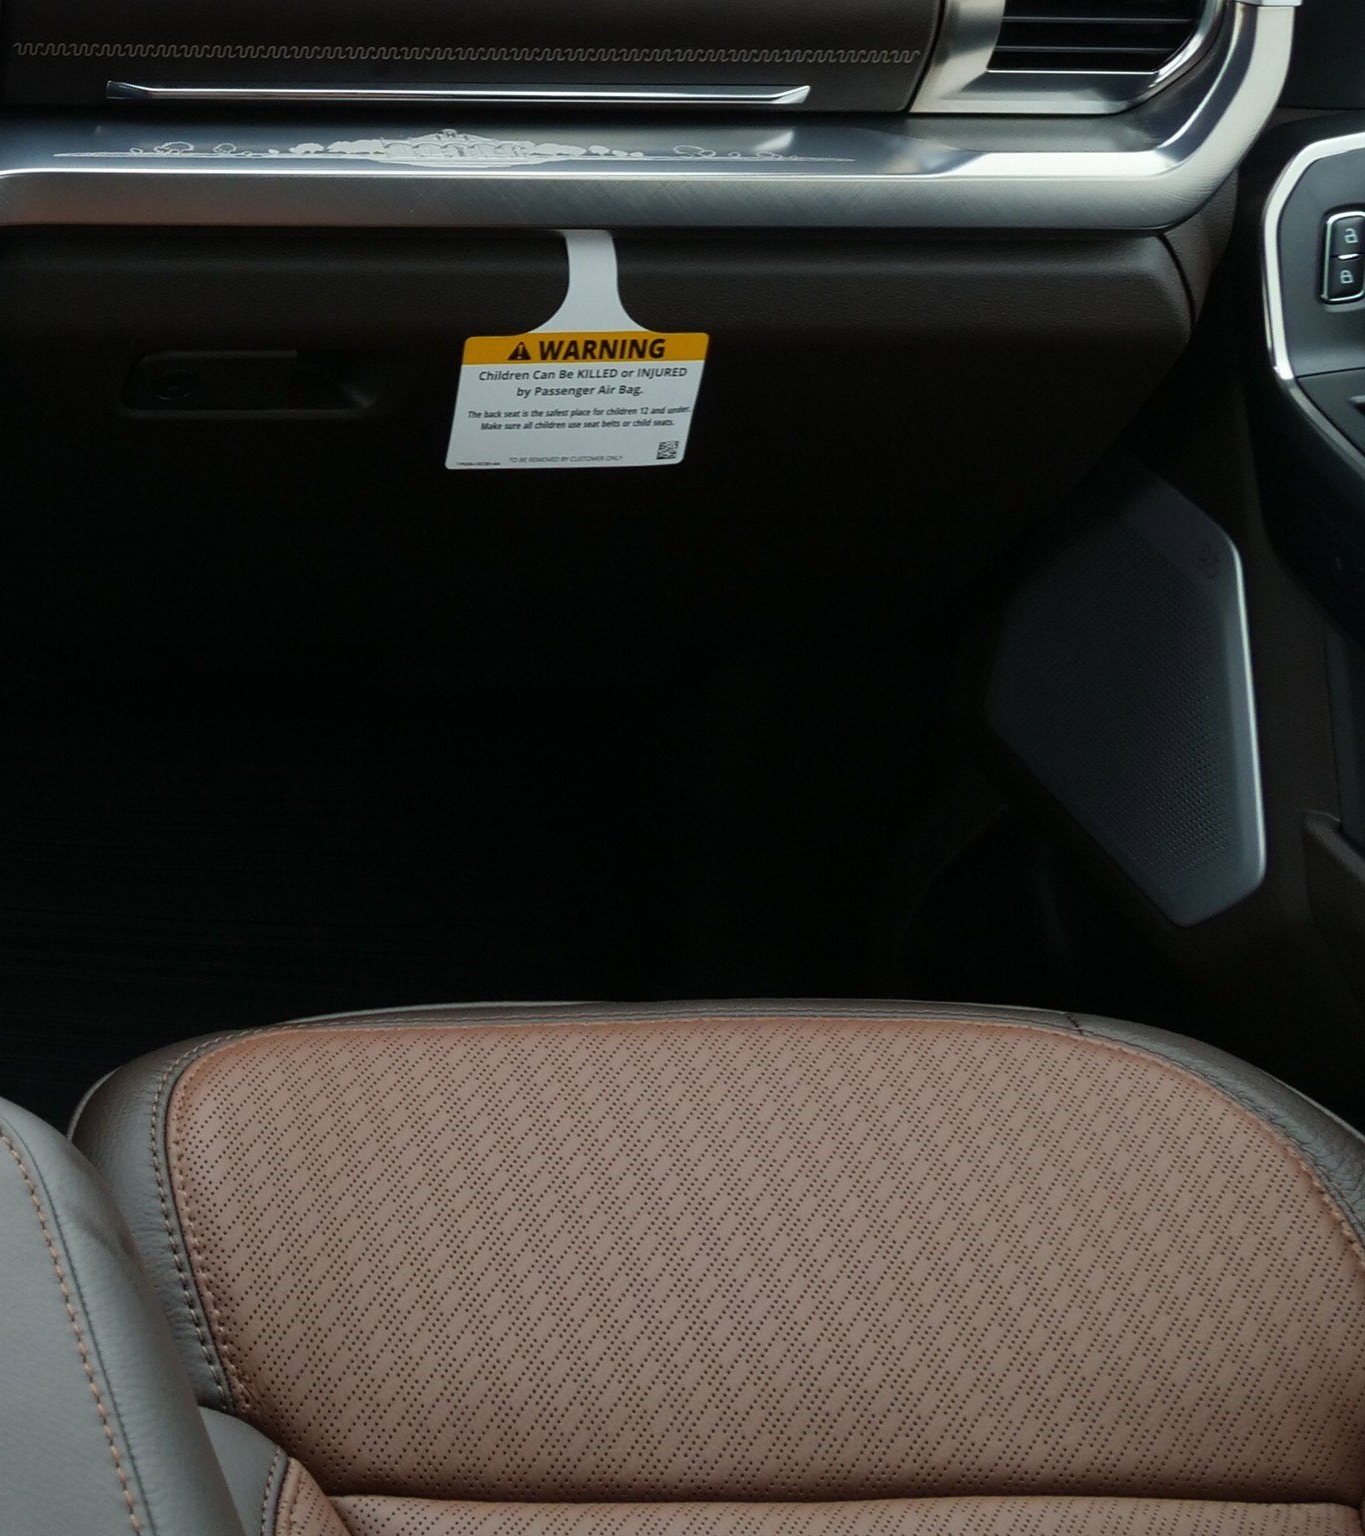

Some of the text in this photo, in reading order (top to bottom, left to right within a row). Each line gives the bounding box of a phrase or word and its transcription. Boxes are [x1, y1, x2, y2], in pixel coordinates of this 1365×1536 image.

[538, 338, 666, 361] WARNING
[478, 367, 688, 381] Children Can Be KILLED or INJURED
[516, 385, 644, 399] by Passenger Air Bag.
[468, 410, 481, 418] The
[483, 410, 502, 418] back
[503, 410, 520, 418] seat
[521, 410, 529, 418] is
[545, 409, 568, 417] safest
[570, 408, 591, 418] place
[592, 408, 604, 416] for
[605, 407, 637, 415] children
[640, 407, 649, 415] 12
[481, 422, 502, 430] Make
[522, 421, 533, 429] all
[535, 421, 566, 429] children
[601, 420, 620, 428] belts
[632, 419, 651, 427] child
